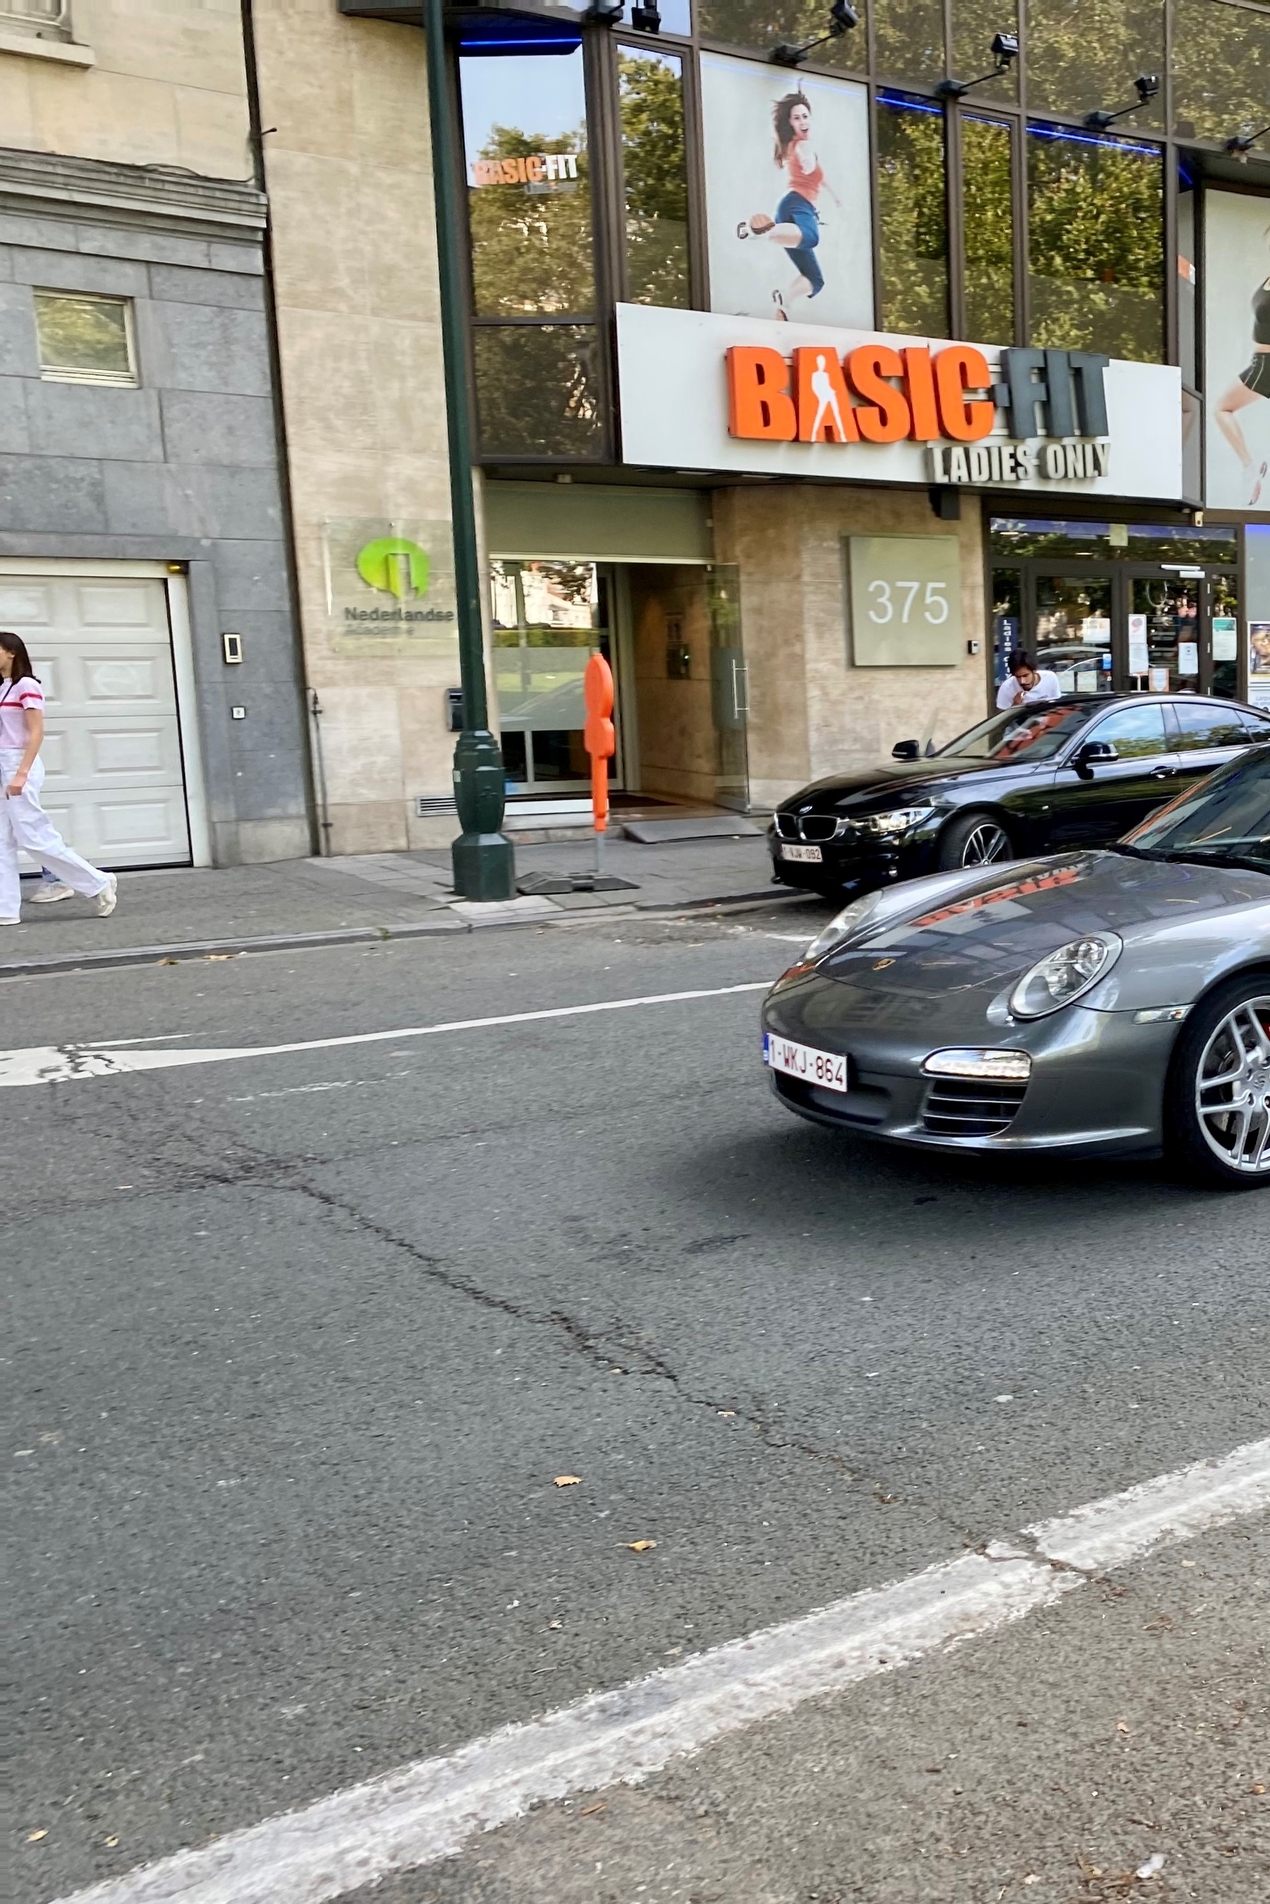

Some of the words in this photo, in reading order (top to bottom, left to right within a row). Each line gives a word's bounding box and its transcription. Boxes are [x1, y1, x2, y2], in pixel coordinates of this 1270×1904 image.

[926, 443, 1033, 483] LADIES
[1038, 442, 1111, 480] ONLY
[344, 606, 455, 621] Nederlandse
[867, 579, 949, 625] 375
[770, 1039, 843, 1086] 1-WKJ-864
